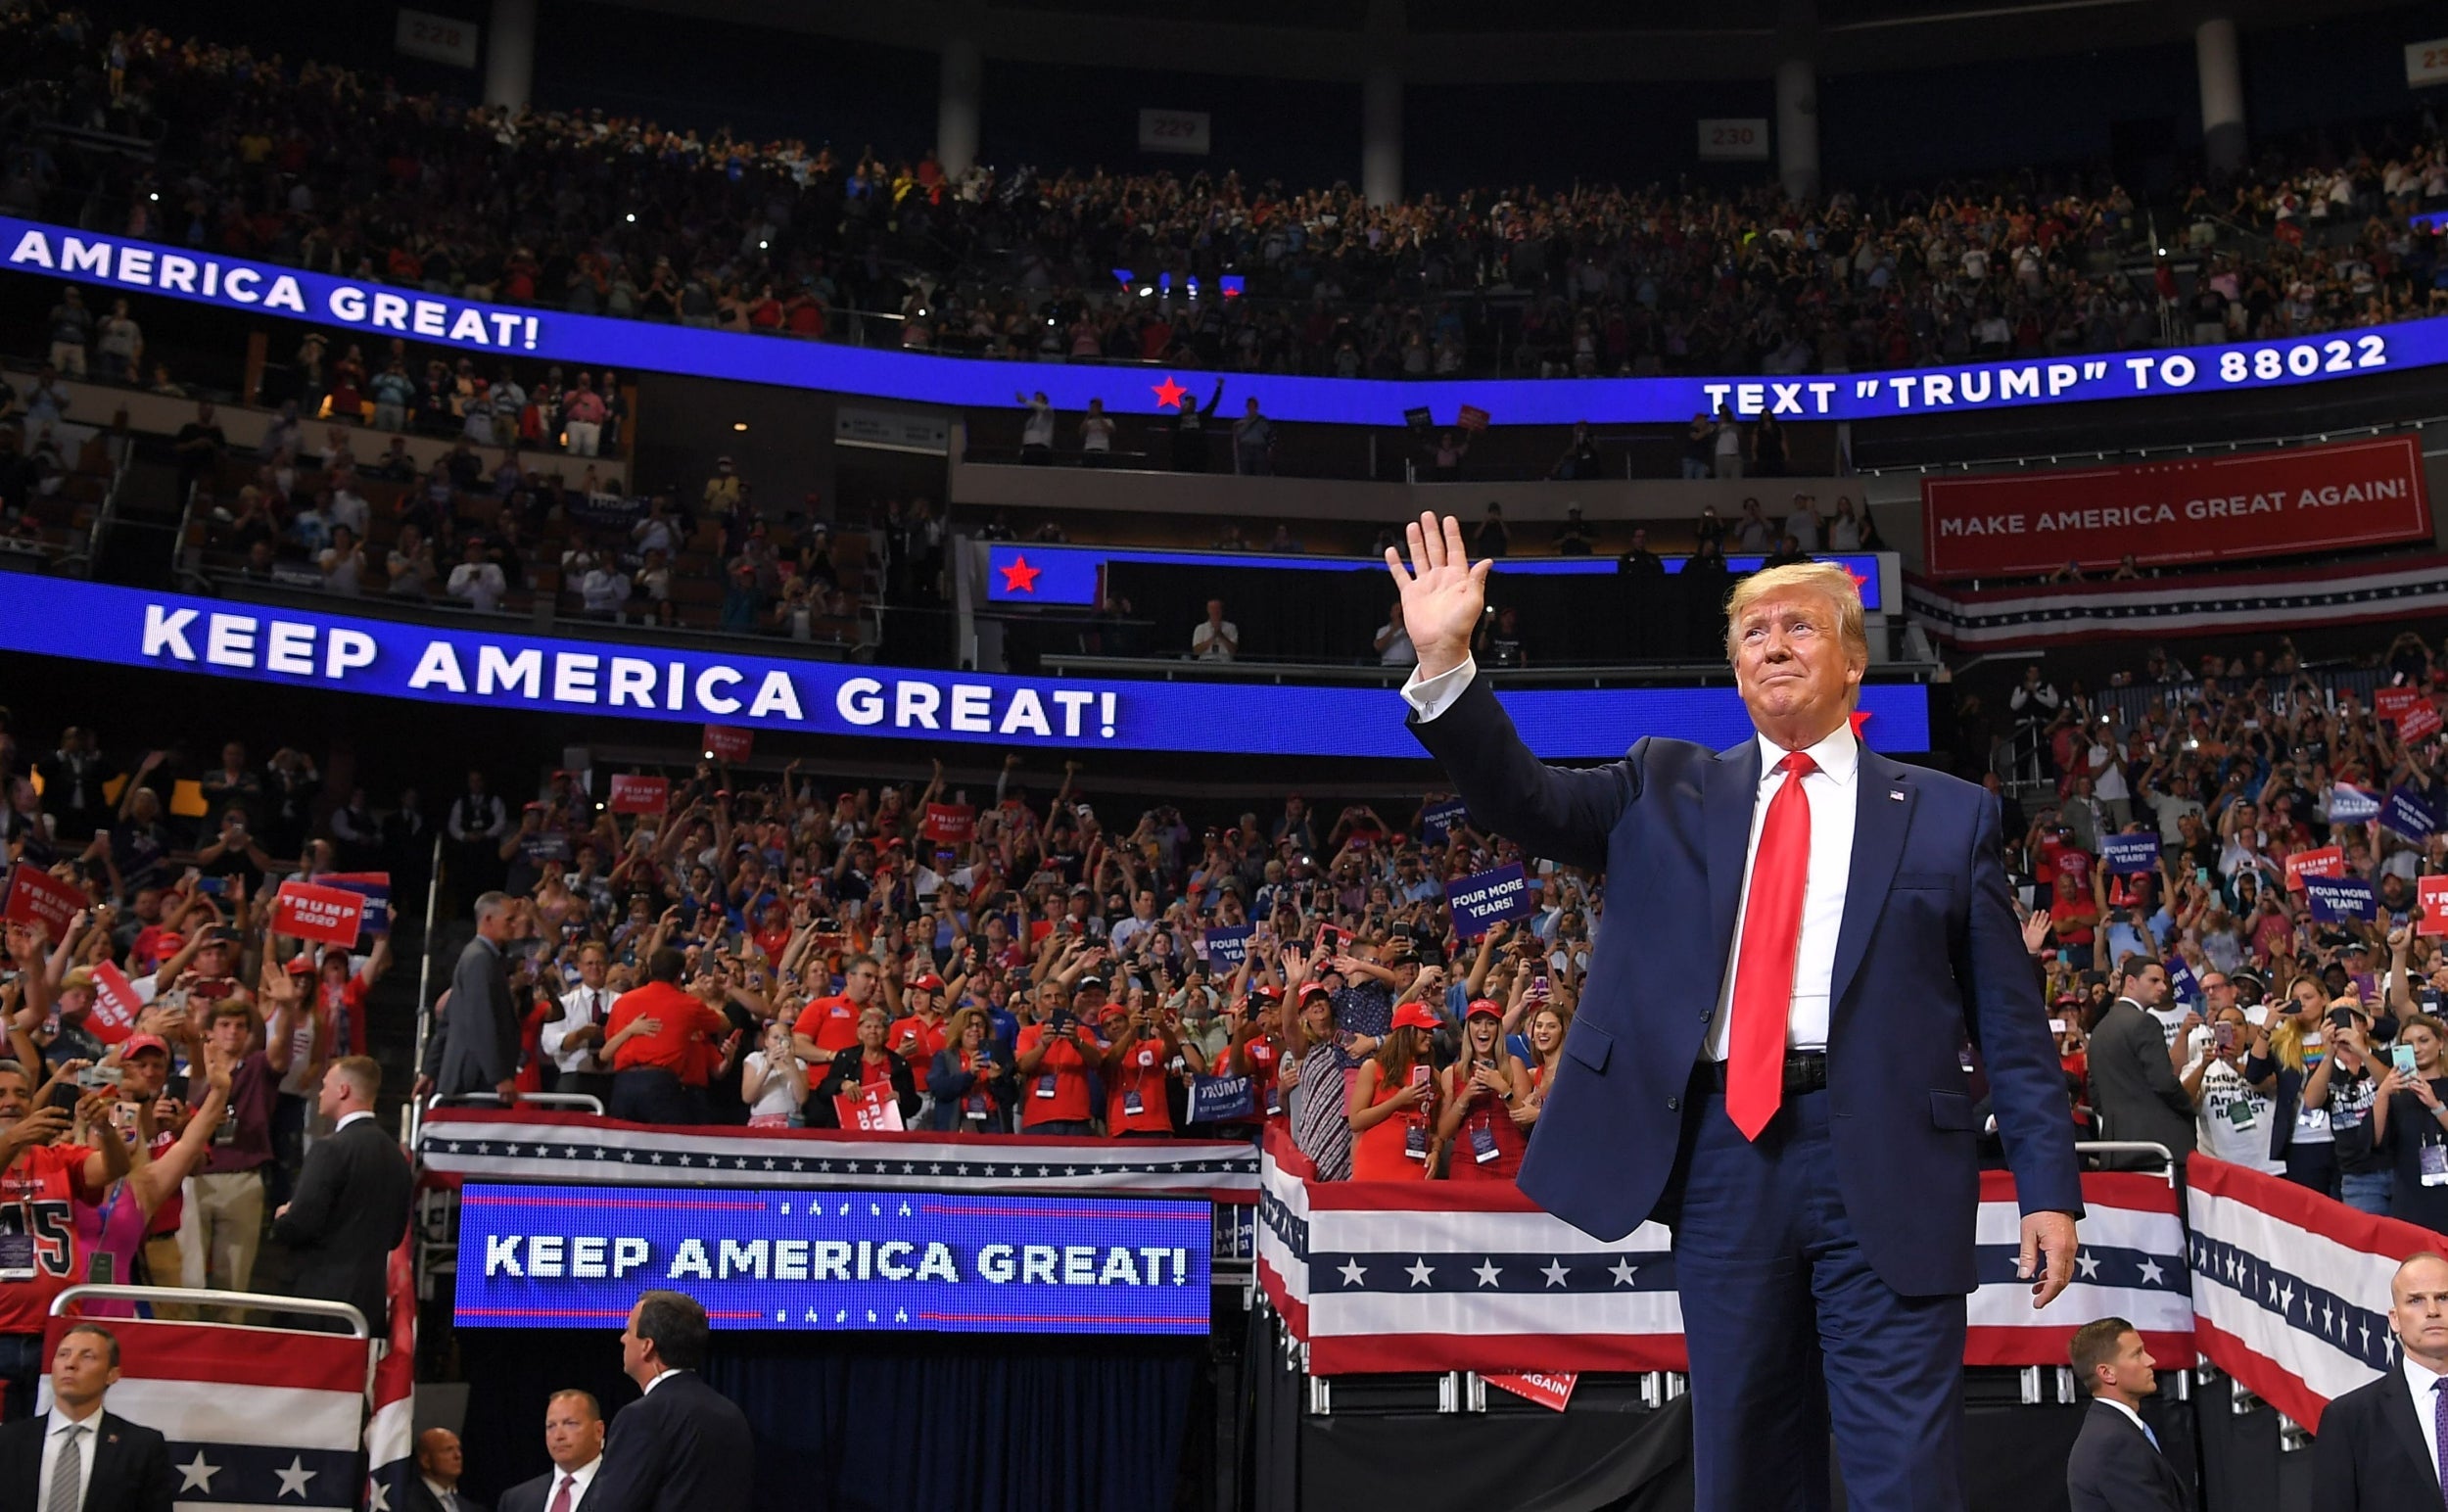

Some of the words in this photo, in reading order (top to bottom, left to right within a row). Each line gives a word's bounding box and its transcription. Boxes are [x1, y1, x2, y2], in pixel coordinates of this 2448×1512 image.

[2424, 48, 2448, 70] 23
[1154, 118, 1196, 138] 229
[1713, 128, 1754, 145] 230
[9, 230, 306, 312] AMERICA
[328, 286, 539, 350] GREAT!
[1703, 382, 1836, 415] TEXT
[2125, 354, 2196, 390] TO
[2220, 334, 2386, 383] 88022
[1940, 513, 2026, 537] MAKE
[2037, 502, 2176, 533] AMERICA
[2185, 491, 2287, 521] GREAT
[2297, 477, 2408, 509] AGAIN!
[141, 604, 376, 679] KEEP
[407, 640, 803, 721] AMERICA
[835, 677, 1116, 738] GREAT!
[2103, 845, 2130, 855] FOUR
[2131, 842, 2156, 853] MORE
[2114, 853, 2147, 864] YEARS!
[2291, 855, 2339, 874] TRUMP
[1451, 889, 1486, 910] FOUR
[1487, 877, 1526, 899] MORE
[2308, 884, 2338, 899] FOUR
[2339, 886, 2374, 901] MORE
[282, 893, 356, 920] TRUMP
[1469, 895, 1515, 920] YEARS!
[2323, 897, 2365, 912] YEARS!
[294, 909, 339, 929] 2020
[1209, 937, 1240, 951] FOUR
[1223, 949, 1246, 961] YEA
[1200, 1076, 1248, 1100] TRUMP
[856, 1109, 871, 1131] 20
[865, 1090, 885, 1131] TRU
[1224, 1224, 1254, 1240] MOR
[485, 1234, 649, 1278] KEEP
[666, 1238, 960, 1283] AMERICA
[977, 1244, 1188, 1288] GREAT!
[1520, 1373, 1568, 1396] AGAIN
